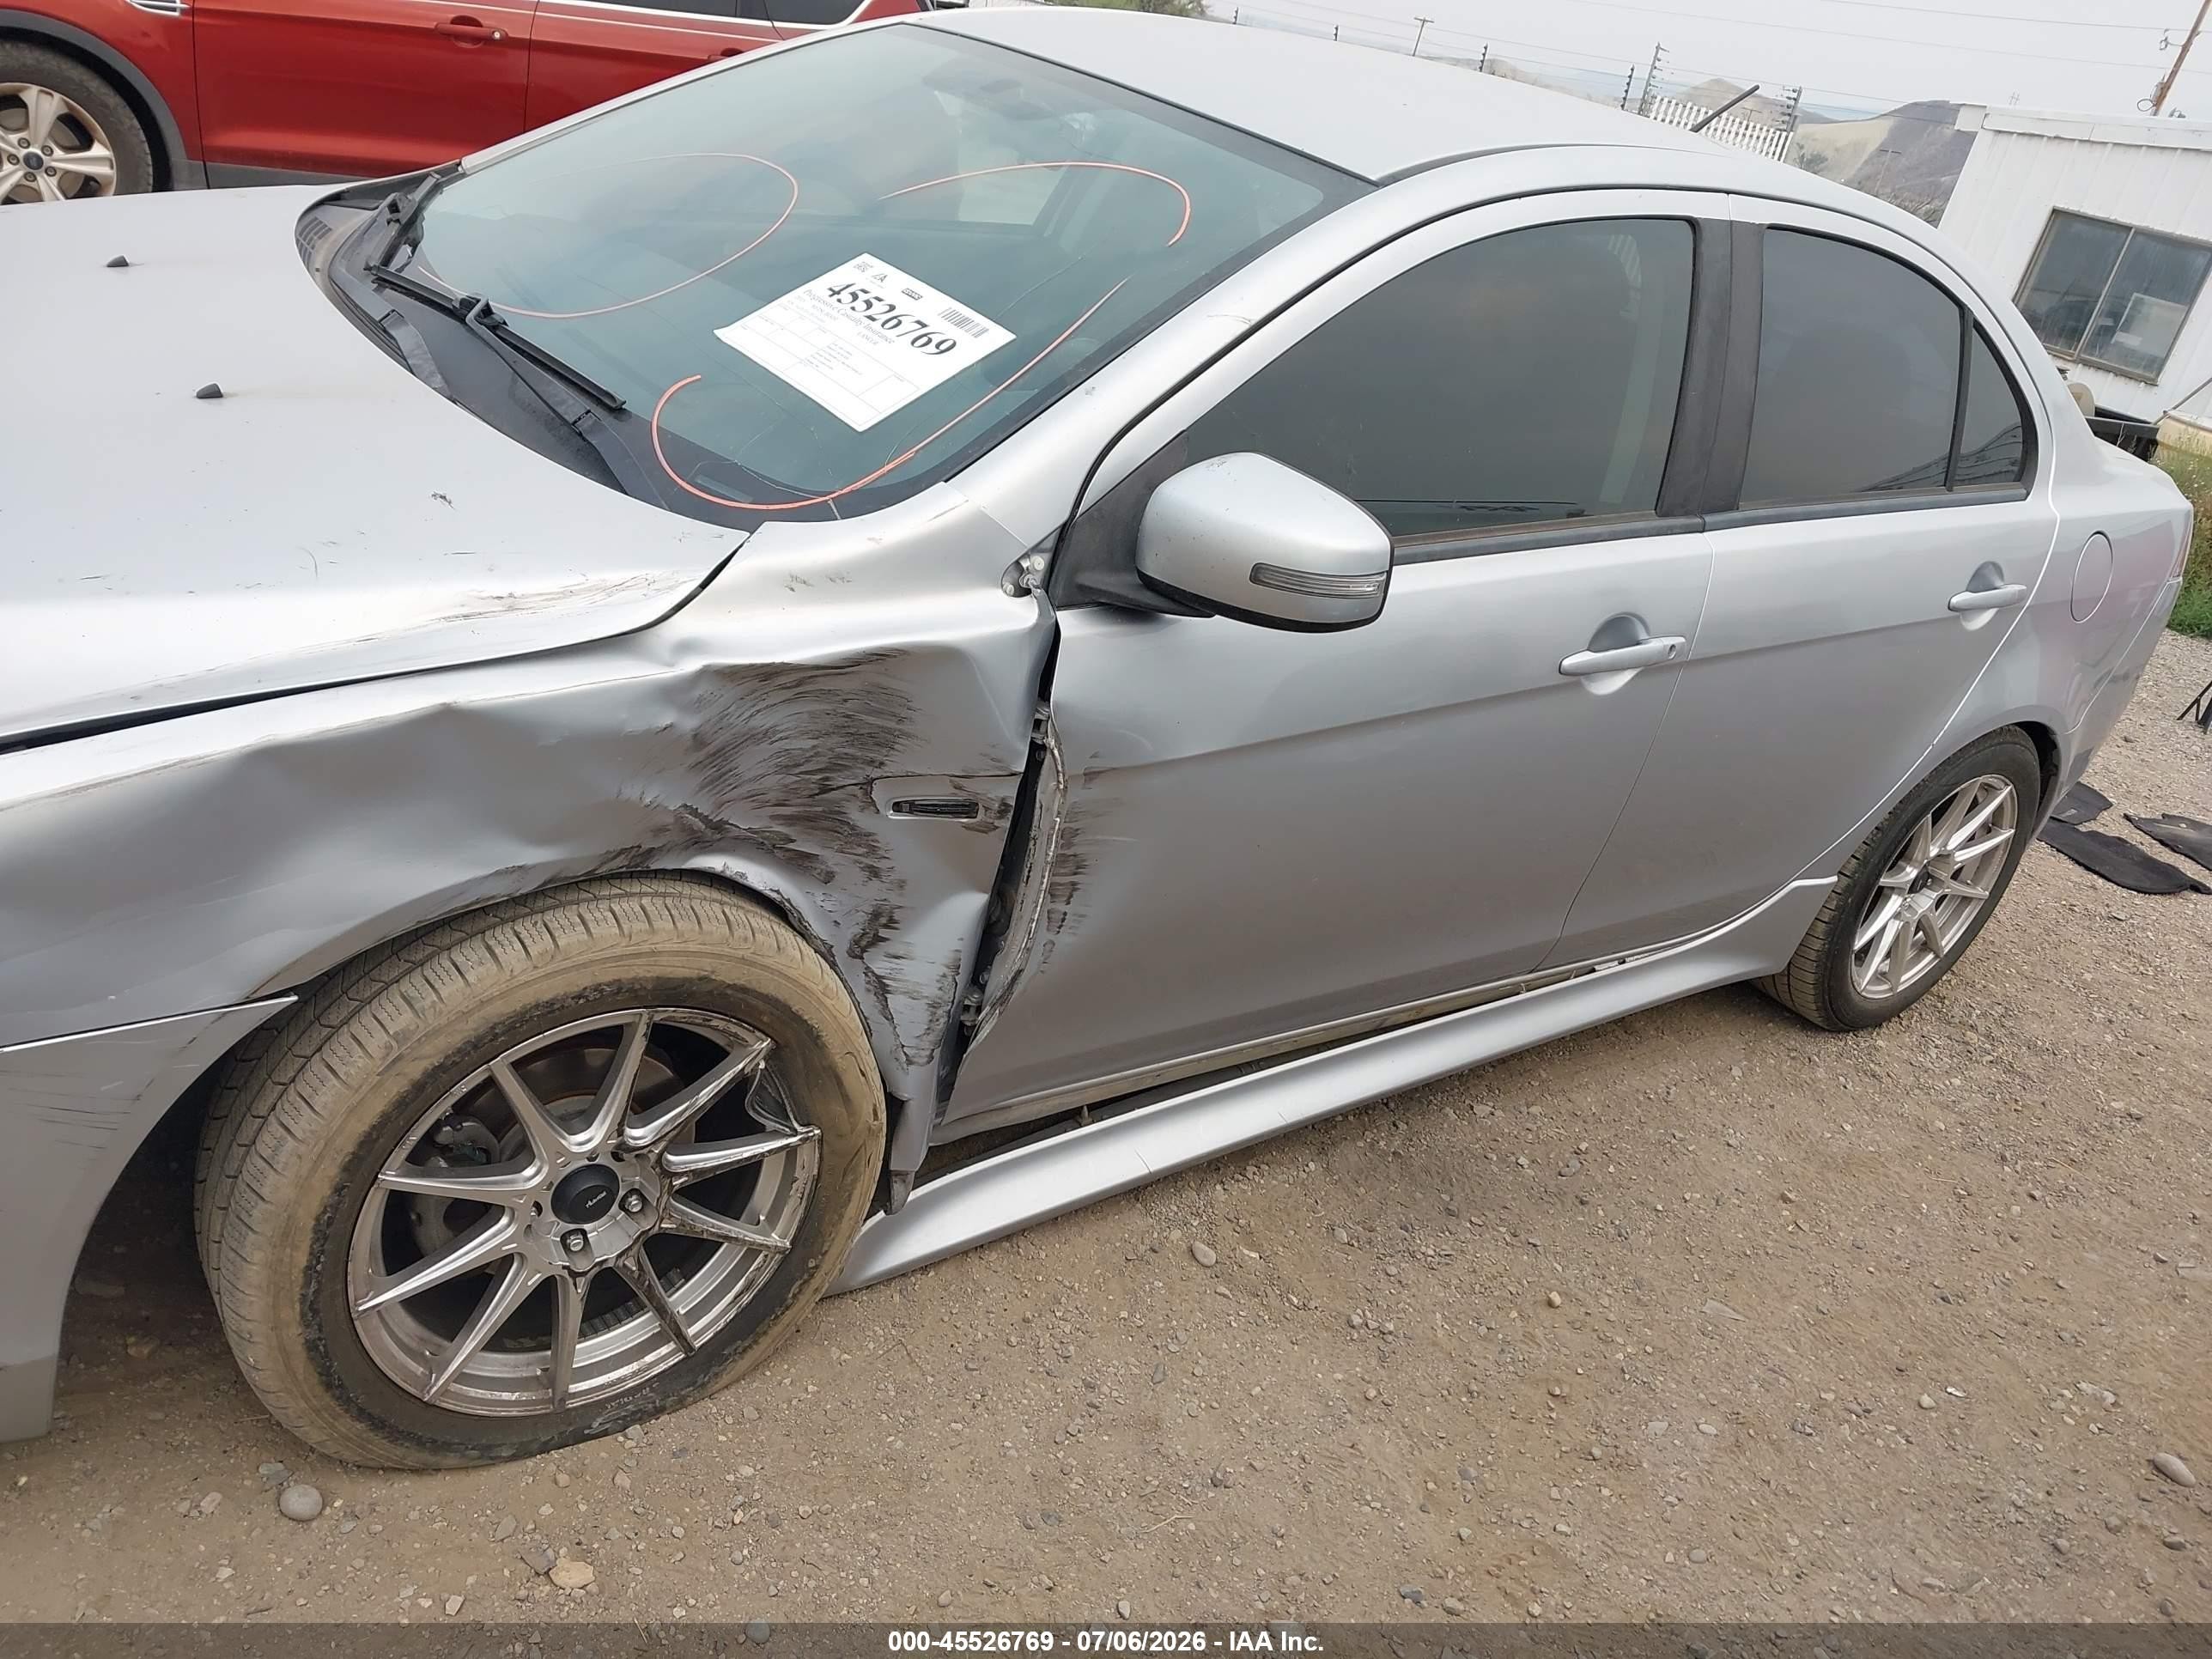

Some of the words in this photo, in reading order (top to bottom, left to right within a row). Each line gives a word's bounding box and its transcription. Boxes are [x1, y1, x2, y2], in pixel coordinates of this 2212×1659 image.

[803, 289, 838, 312] Progressive
[863, 322, 896, 344] Insurance
[827, 283, 957, 356] 45526769
